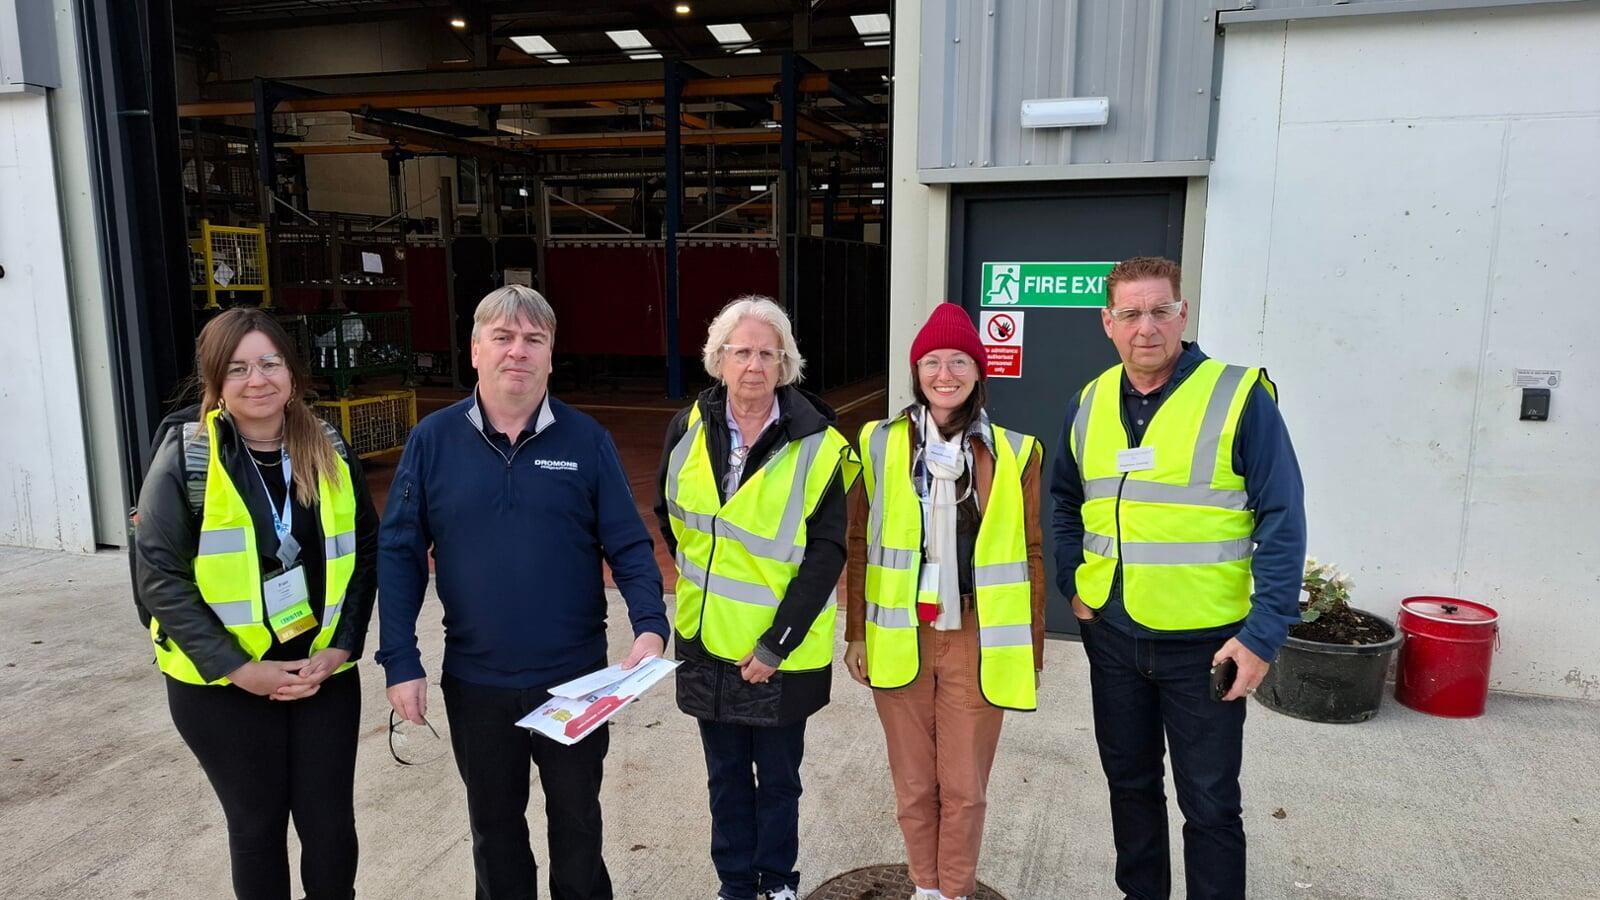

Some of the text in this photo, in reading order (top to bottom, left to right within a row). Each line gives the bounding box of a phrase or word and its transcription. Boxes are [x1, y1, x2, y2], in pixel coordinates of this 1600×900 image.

[1024, 276, 1107, 293] FIRE EXI
[534, 459, 578, 468] DROMONE
